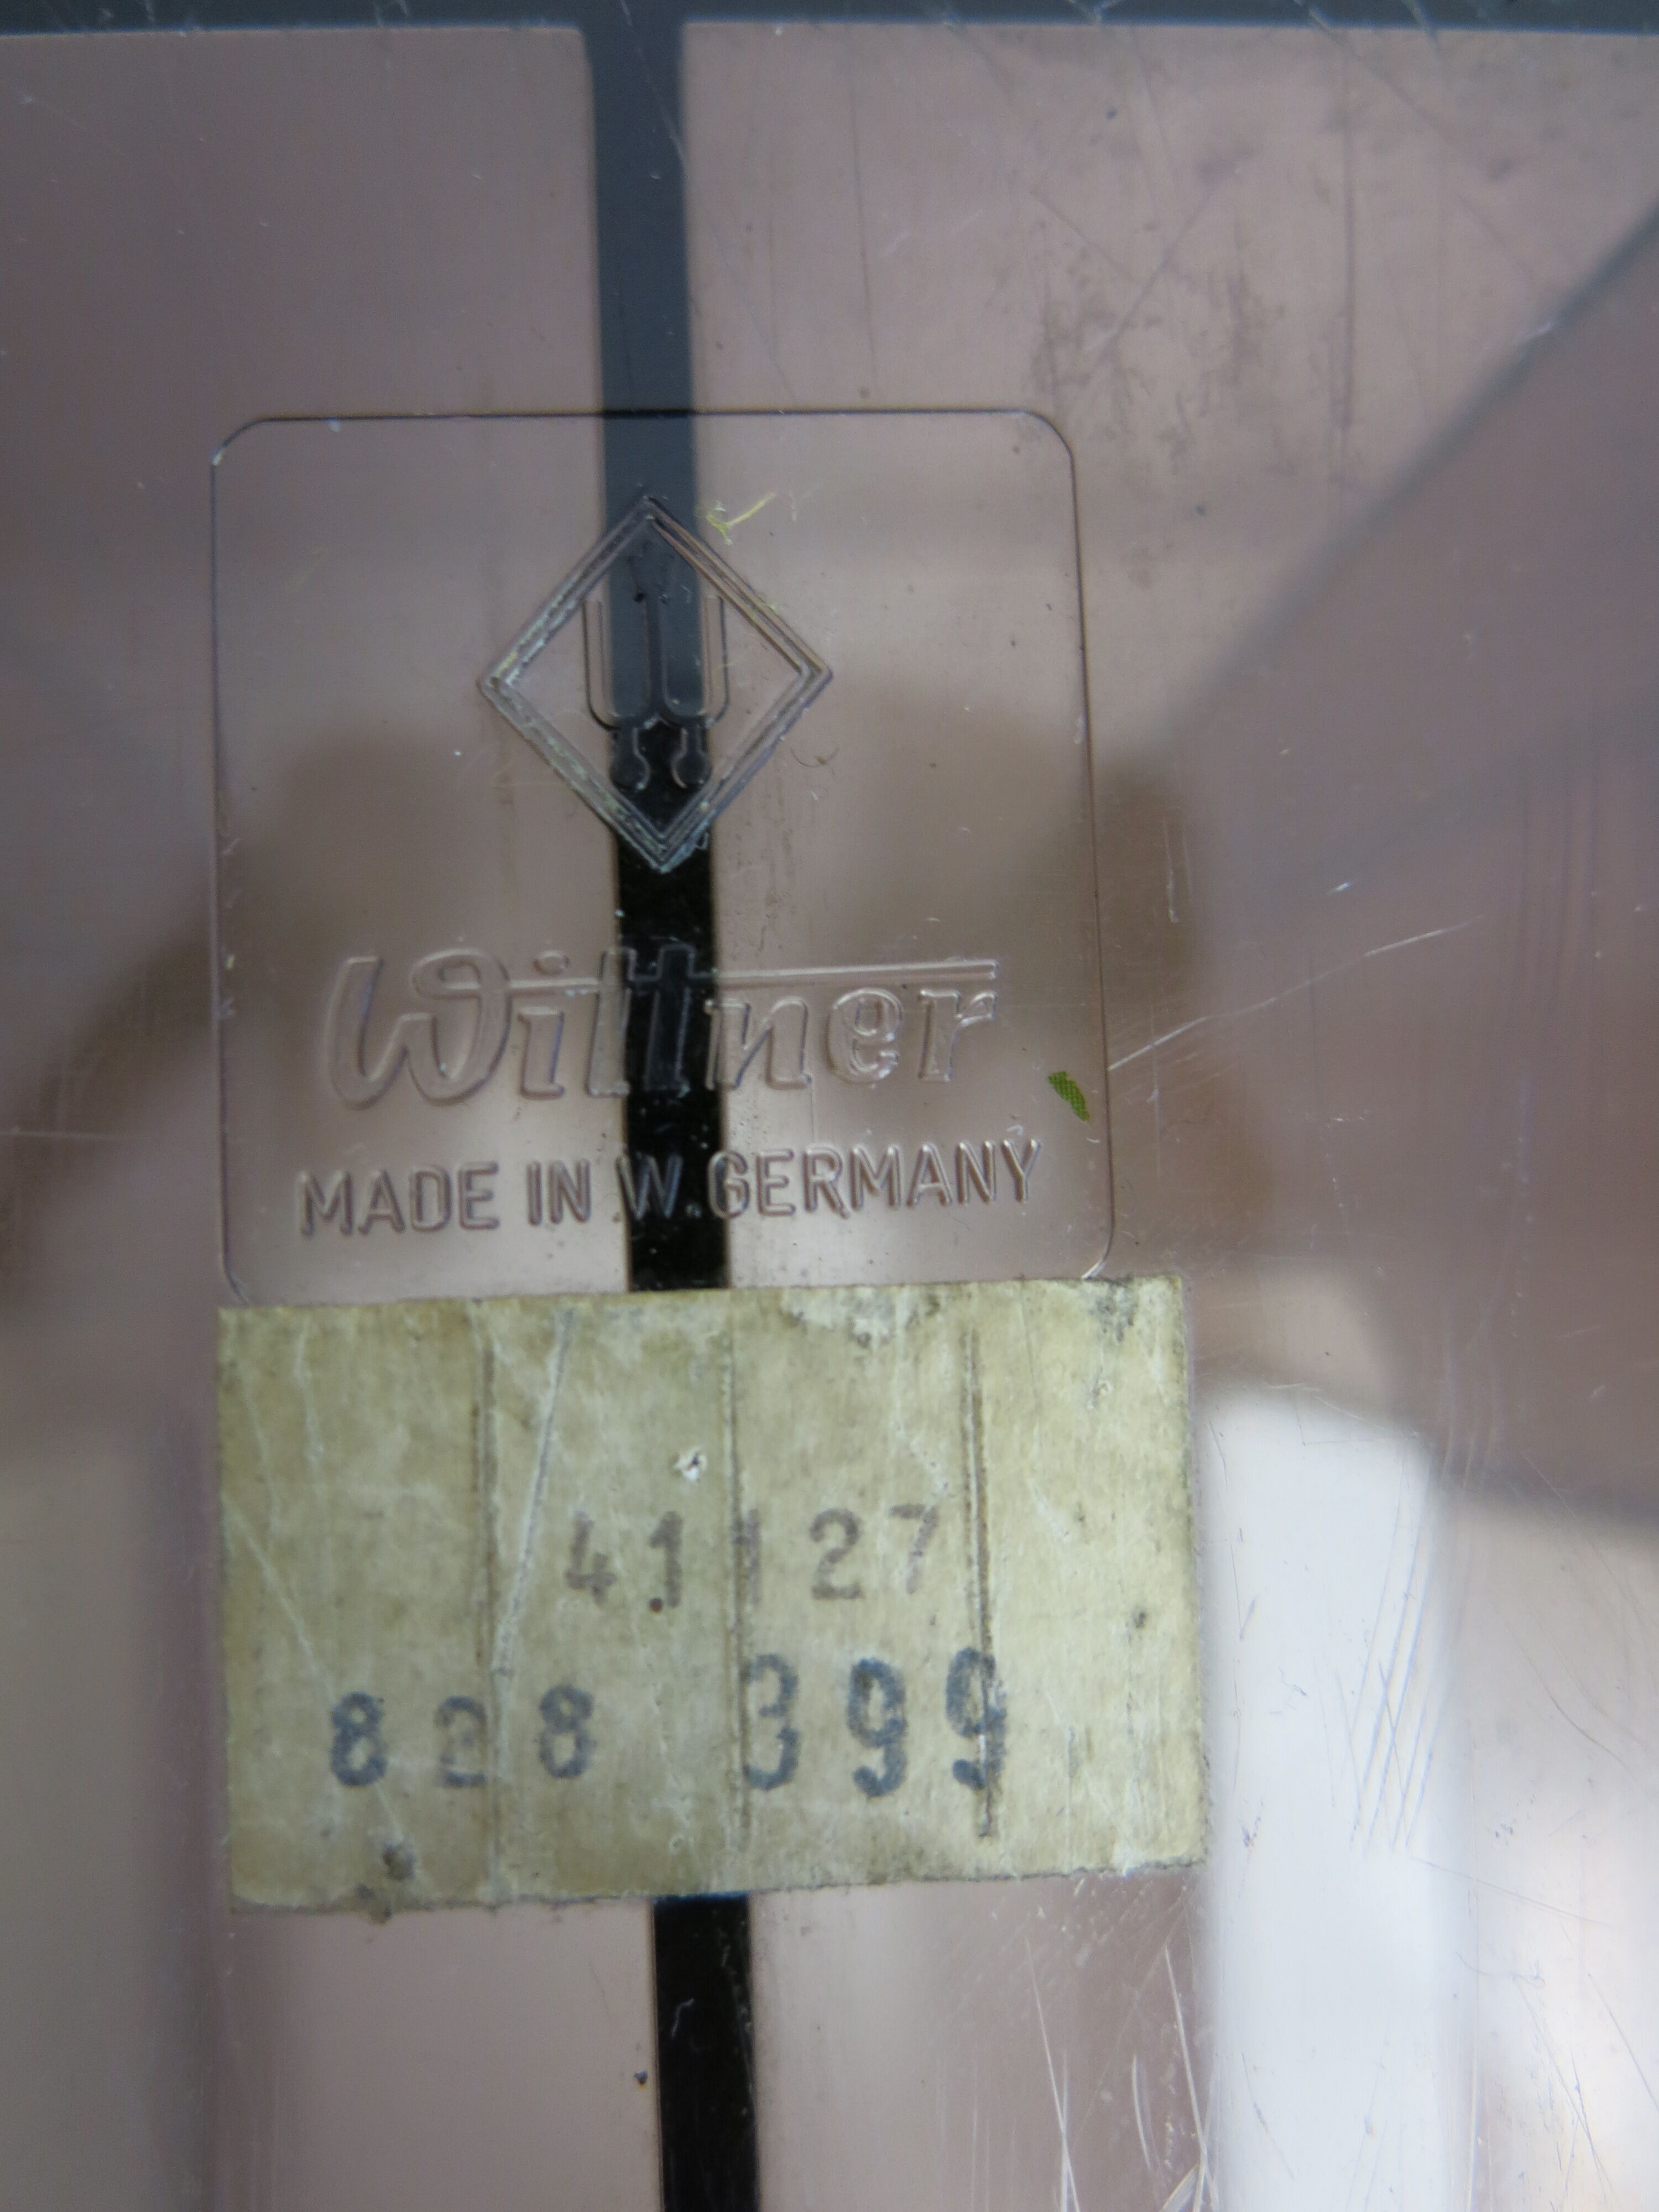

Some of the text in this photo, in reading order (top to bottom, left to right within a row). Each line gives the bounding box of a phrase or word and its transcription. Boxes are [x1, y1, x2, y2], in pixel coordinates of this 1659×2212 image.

[325, 942, 999, 1110] Wittner
[299, 1160, 500, 1237] MADE
[527, 1157, 591, 1227] IN
